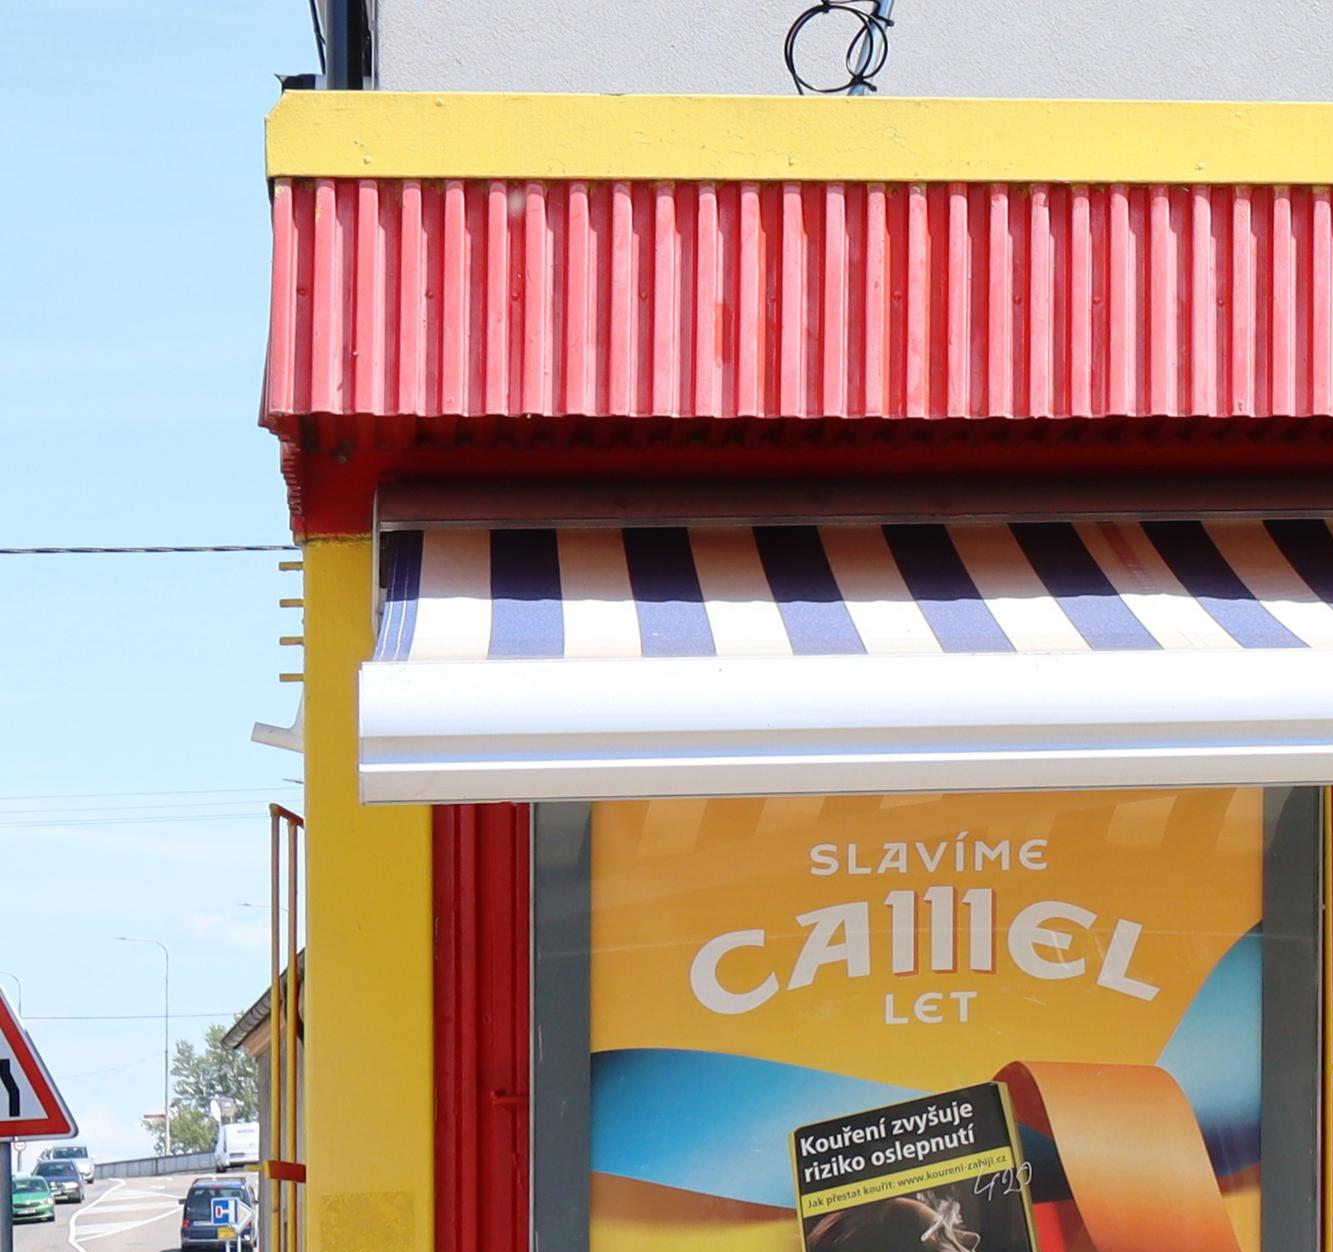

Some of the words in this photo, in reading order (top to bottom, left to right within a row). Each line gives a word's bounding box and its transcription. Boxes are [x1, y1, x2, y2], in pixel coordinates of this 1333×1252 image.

[809, 831, 1049, 877] SLAVÍME
[884, 990, 978, 1025] LET
[799, 1116, 888, 1158] Kouření
[892, 1101, 974, 1136] zvyšuje
[803, 1152, 867, 1184] riziko
[870, 1122, 976, 1168] oslepnutí
[807, 1196, 825, 1210] Jak
[825, 1185, 862, 1207] přestat
[862, 1178, 897, 1198] kouřit:
